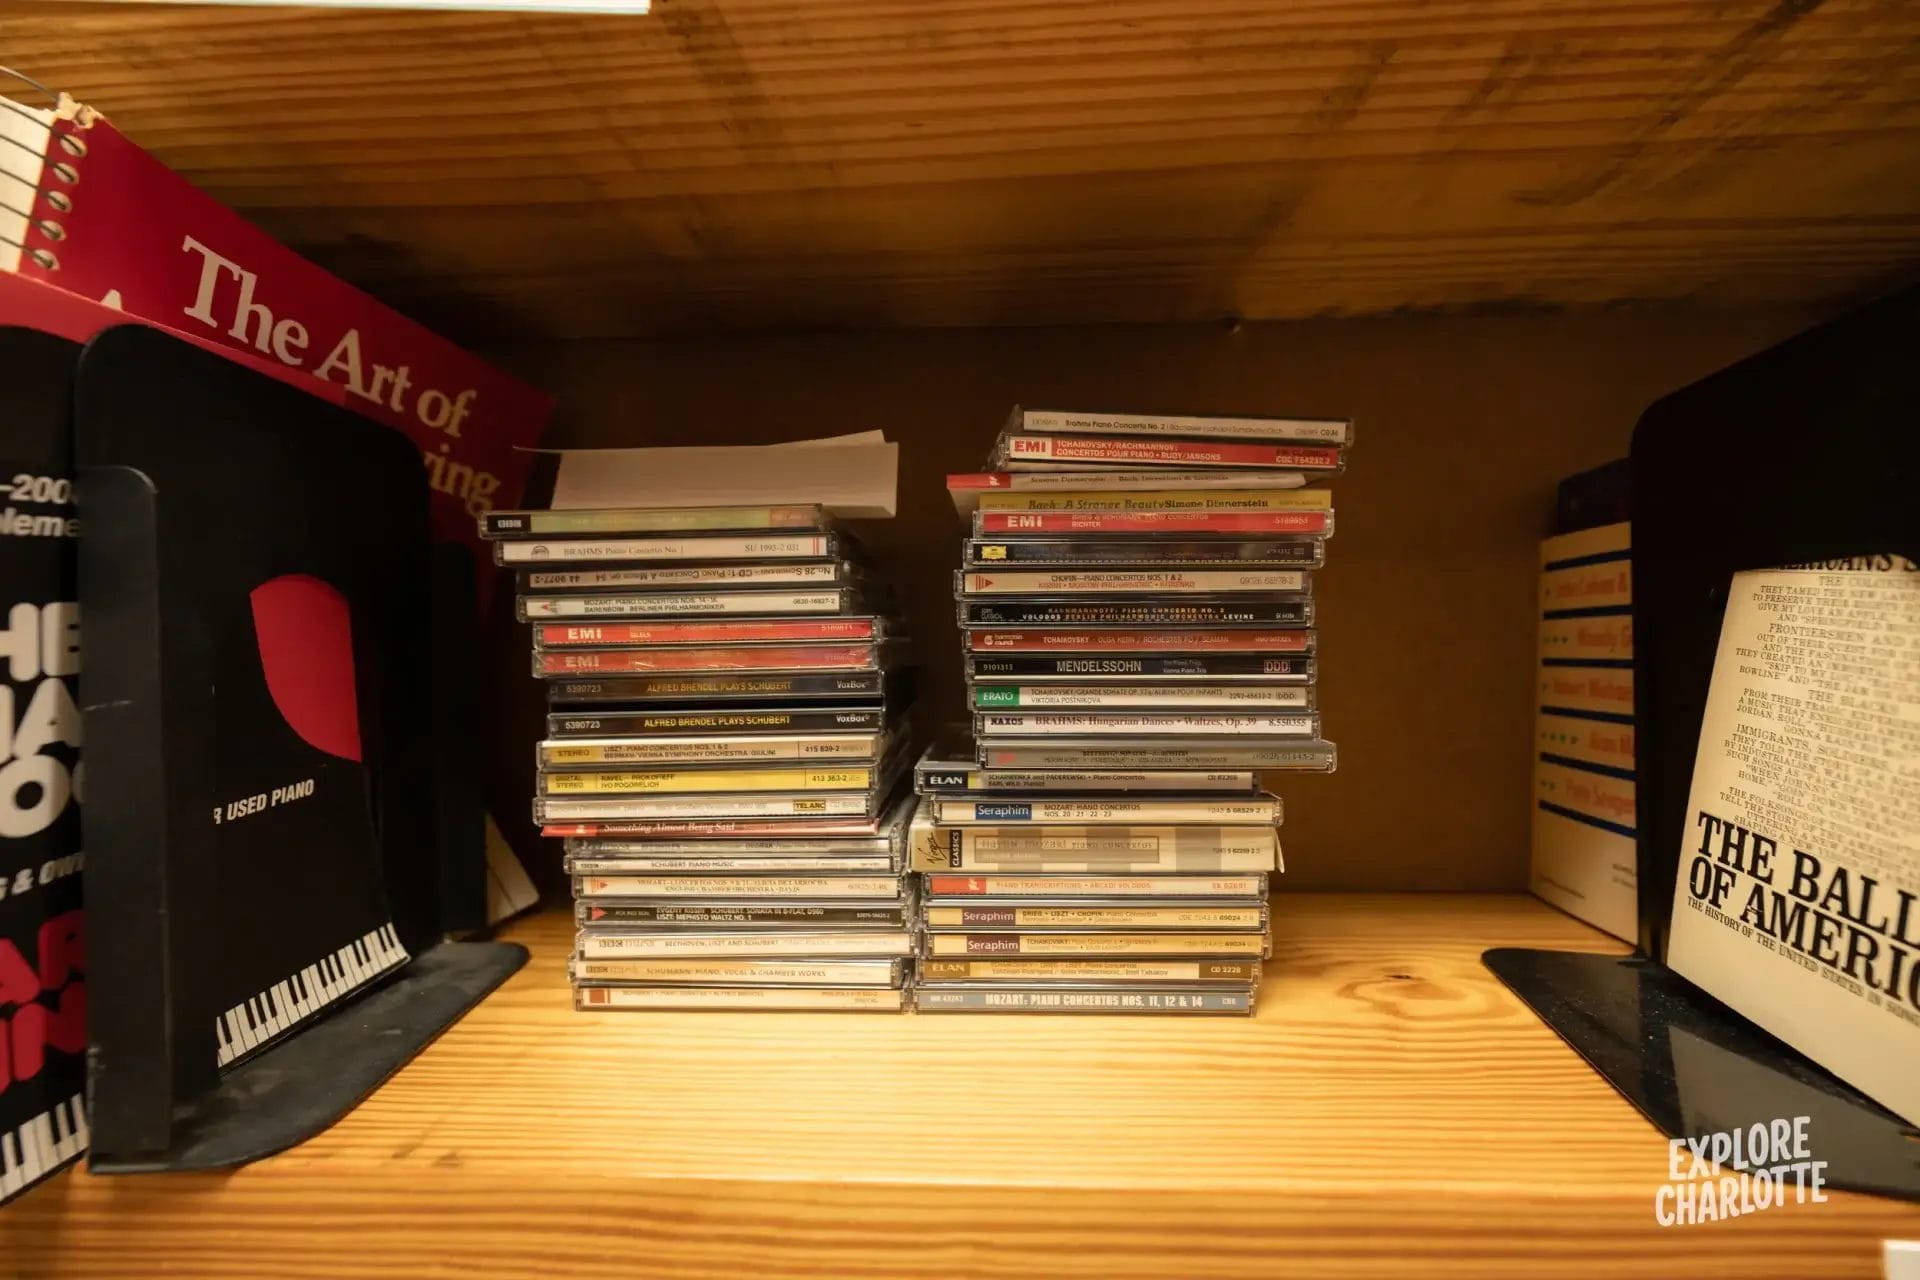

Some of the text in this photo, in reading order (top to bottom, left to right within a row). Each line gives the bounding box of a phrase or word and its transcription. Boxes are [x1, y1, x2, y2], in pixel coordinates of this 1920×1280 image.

[182, 235, 478, 439] The Art of
[1014, 439, 1046, 453] EMI
[1106, 450, 1130, 459] POUR
[1130, 451, 1155, 460] PIANO
[1063, 497, 1269, 511] A Strange Beauty Simone Dinnerstein
[1007, 515, 1042, 528] EMI
[563, 546, 602, 557] BRAHMS
[1760, 584, 1785, 595] THEY
[1758, 601, 1796, 614] GIVE MY
[1022, 613, 1062, 622] VOLODOS
[1223, 613, 1256, 622] LEVINE
[1776, 612, 1798, 623] AND
[567, 626, 603, 641] EMI
[1756, 632, 1776, 644] OUT
[1735, 646, 1806, 666] THEY CREATED
[1762, 642, 1806, 657] AND THE
[564, 655, 600, 669] EMI
[1056, 659, 1142, 674] MENDELSSOHN
[1265, 660, 1290, 673] DDD
[647, 681, 792, 693] ALFRED BRENDEL PLAYS SCHUBERT
[1743, 686, 1769, 701] FROM
[983, 691, 1013, 702] ERATO
[644, 715, 792, 729] ALFRED BRENDEL PLAYS SCHUBERT
[990, 716, 1023, 726] NAXOS
[1035, 716, 1257, 730] BRAHMS: Hungarian Dances Waltzes, Op. 39
[1731, 733, 1758, 749] THEY
[556, 749, 590, 759] STEREO
[1725, 748, 1751, 764] SUCH
[555, 781, 584, 789] STEREO
[226, 778, 316, 822] USED PIANO
[1728, 786, 1748, 800] THE
[1076, 803, 1098, 811] PIANO
[1099, 803, 1142, 812] CONCERTOS
[1719, 793, 1744, 808] TELL
[1744, 799, 1764, 814] THE
[977, 804, 1029, 820] Seraphim
[1044, 810, 1098, 818] NOS. 20 21 22
[951, 831, 961, 867] CLASSICS
[1697, 810, 1778, 886] THE
[1689, 854, 1737, 910] OF
[676, 913, 710, 921] MEPHISTO
[711, 913, 732, 921] WALTZ
[963, 911, 1014, 926] Seraphim
[1686, 896, 1704, 913] THE
[1704, 903, 1742, 932] HISTORY
[1741, 924, 1755, 940] OF
[1755, 932, 1777, 952] THE
[967, 939, 1019, 954] Seraphim
[798, 969, 827, 979] WORKS
[984, 993, 1028, 1006] MOZART:
[1030, 993, 1060, 1006] PIANO
[1063, 993, 1120, 1007] CONCERTOS
[1121, 993, 1145, 1007] NOS.
[1164, 994, 1177, 1007] 12
[1178, 994, 1189, 1007] &
[1191, 994, 1204, 1007] 14
